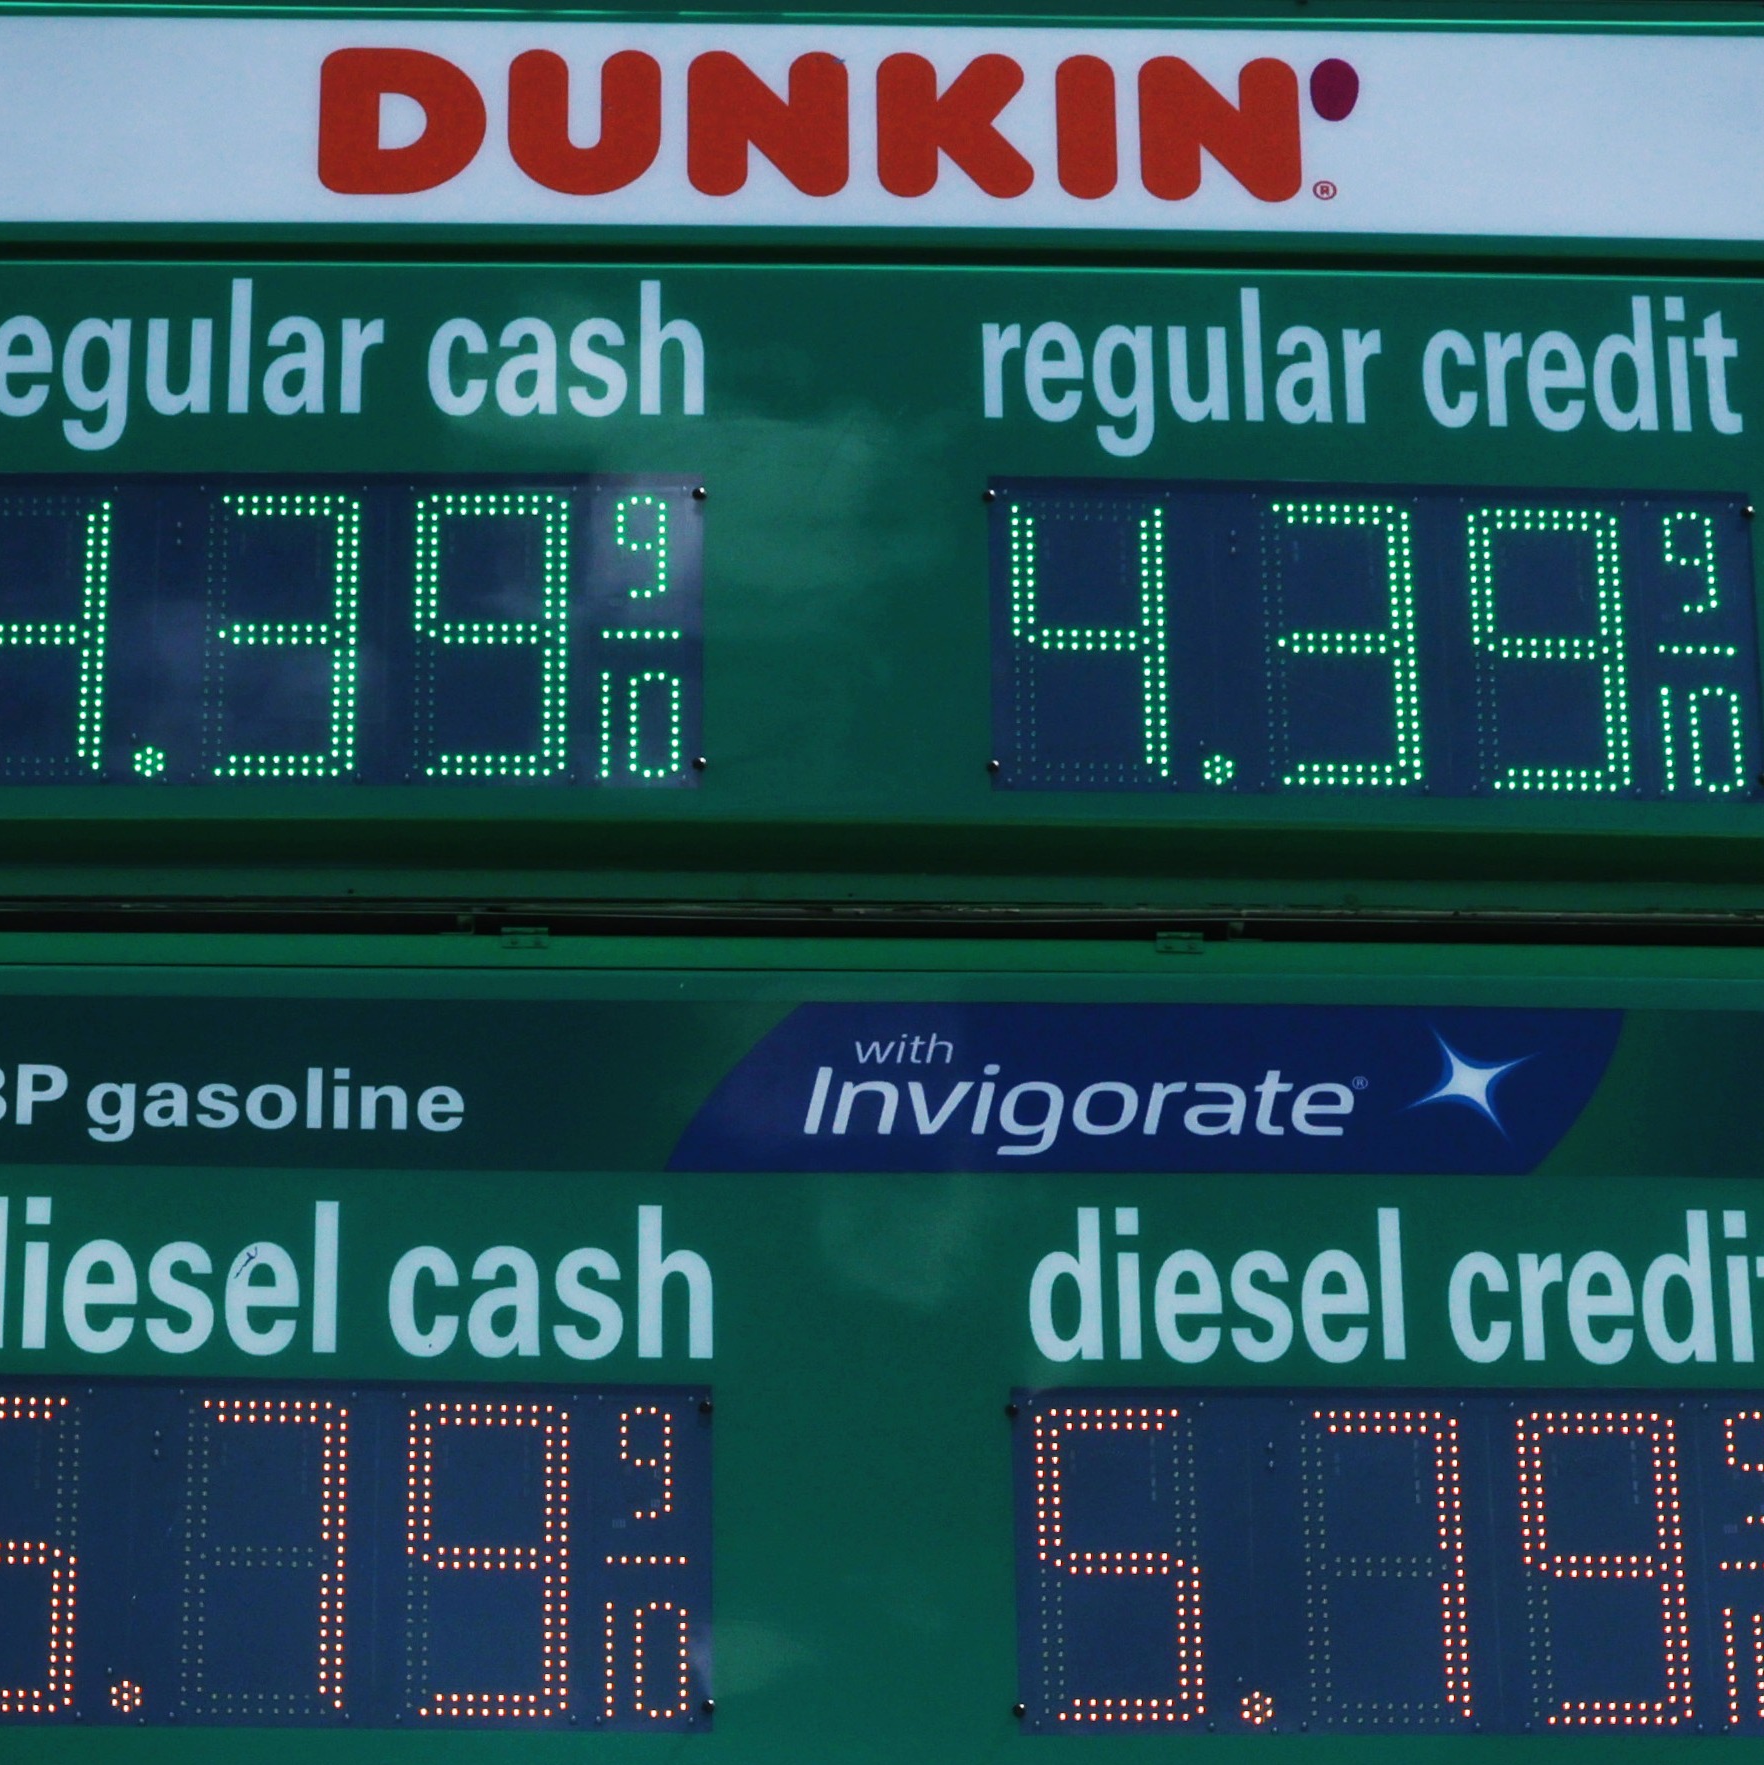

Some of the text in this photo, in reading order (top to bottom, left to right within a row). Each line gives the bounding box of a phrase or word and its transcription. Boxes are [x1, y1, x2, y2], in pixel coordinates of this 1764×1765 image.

[317, 47, 1359, 203] DUNKIN'
[427, 279, 705, 418] cash
[981, 286, 1743, 457] regular credit
[1010, 502, 1632, 793] 4.39
[85, 1067, 466, 1143] gasoline
[802, 1065, 1354, 1157] Invigorate
[853, 1031, 955, 1065] with
[387, 1204, 714, 1361] cash
[1027, 1206, 1406, 1364] diesel
[1034, 1407, 1695, 1728] 5.79
